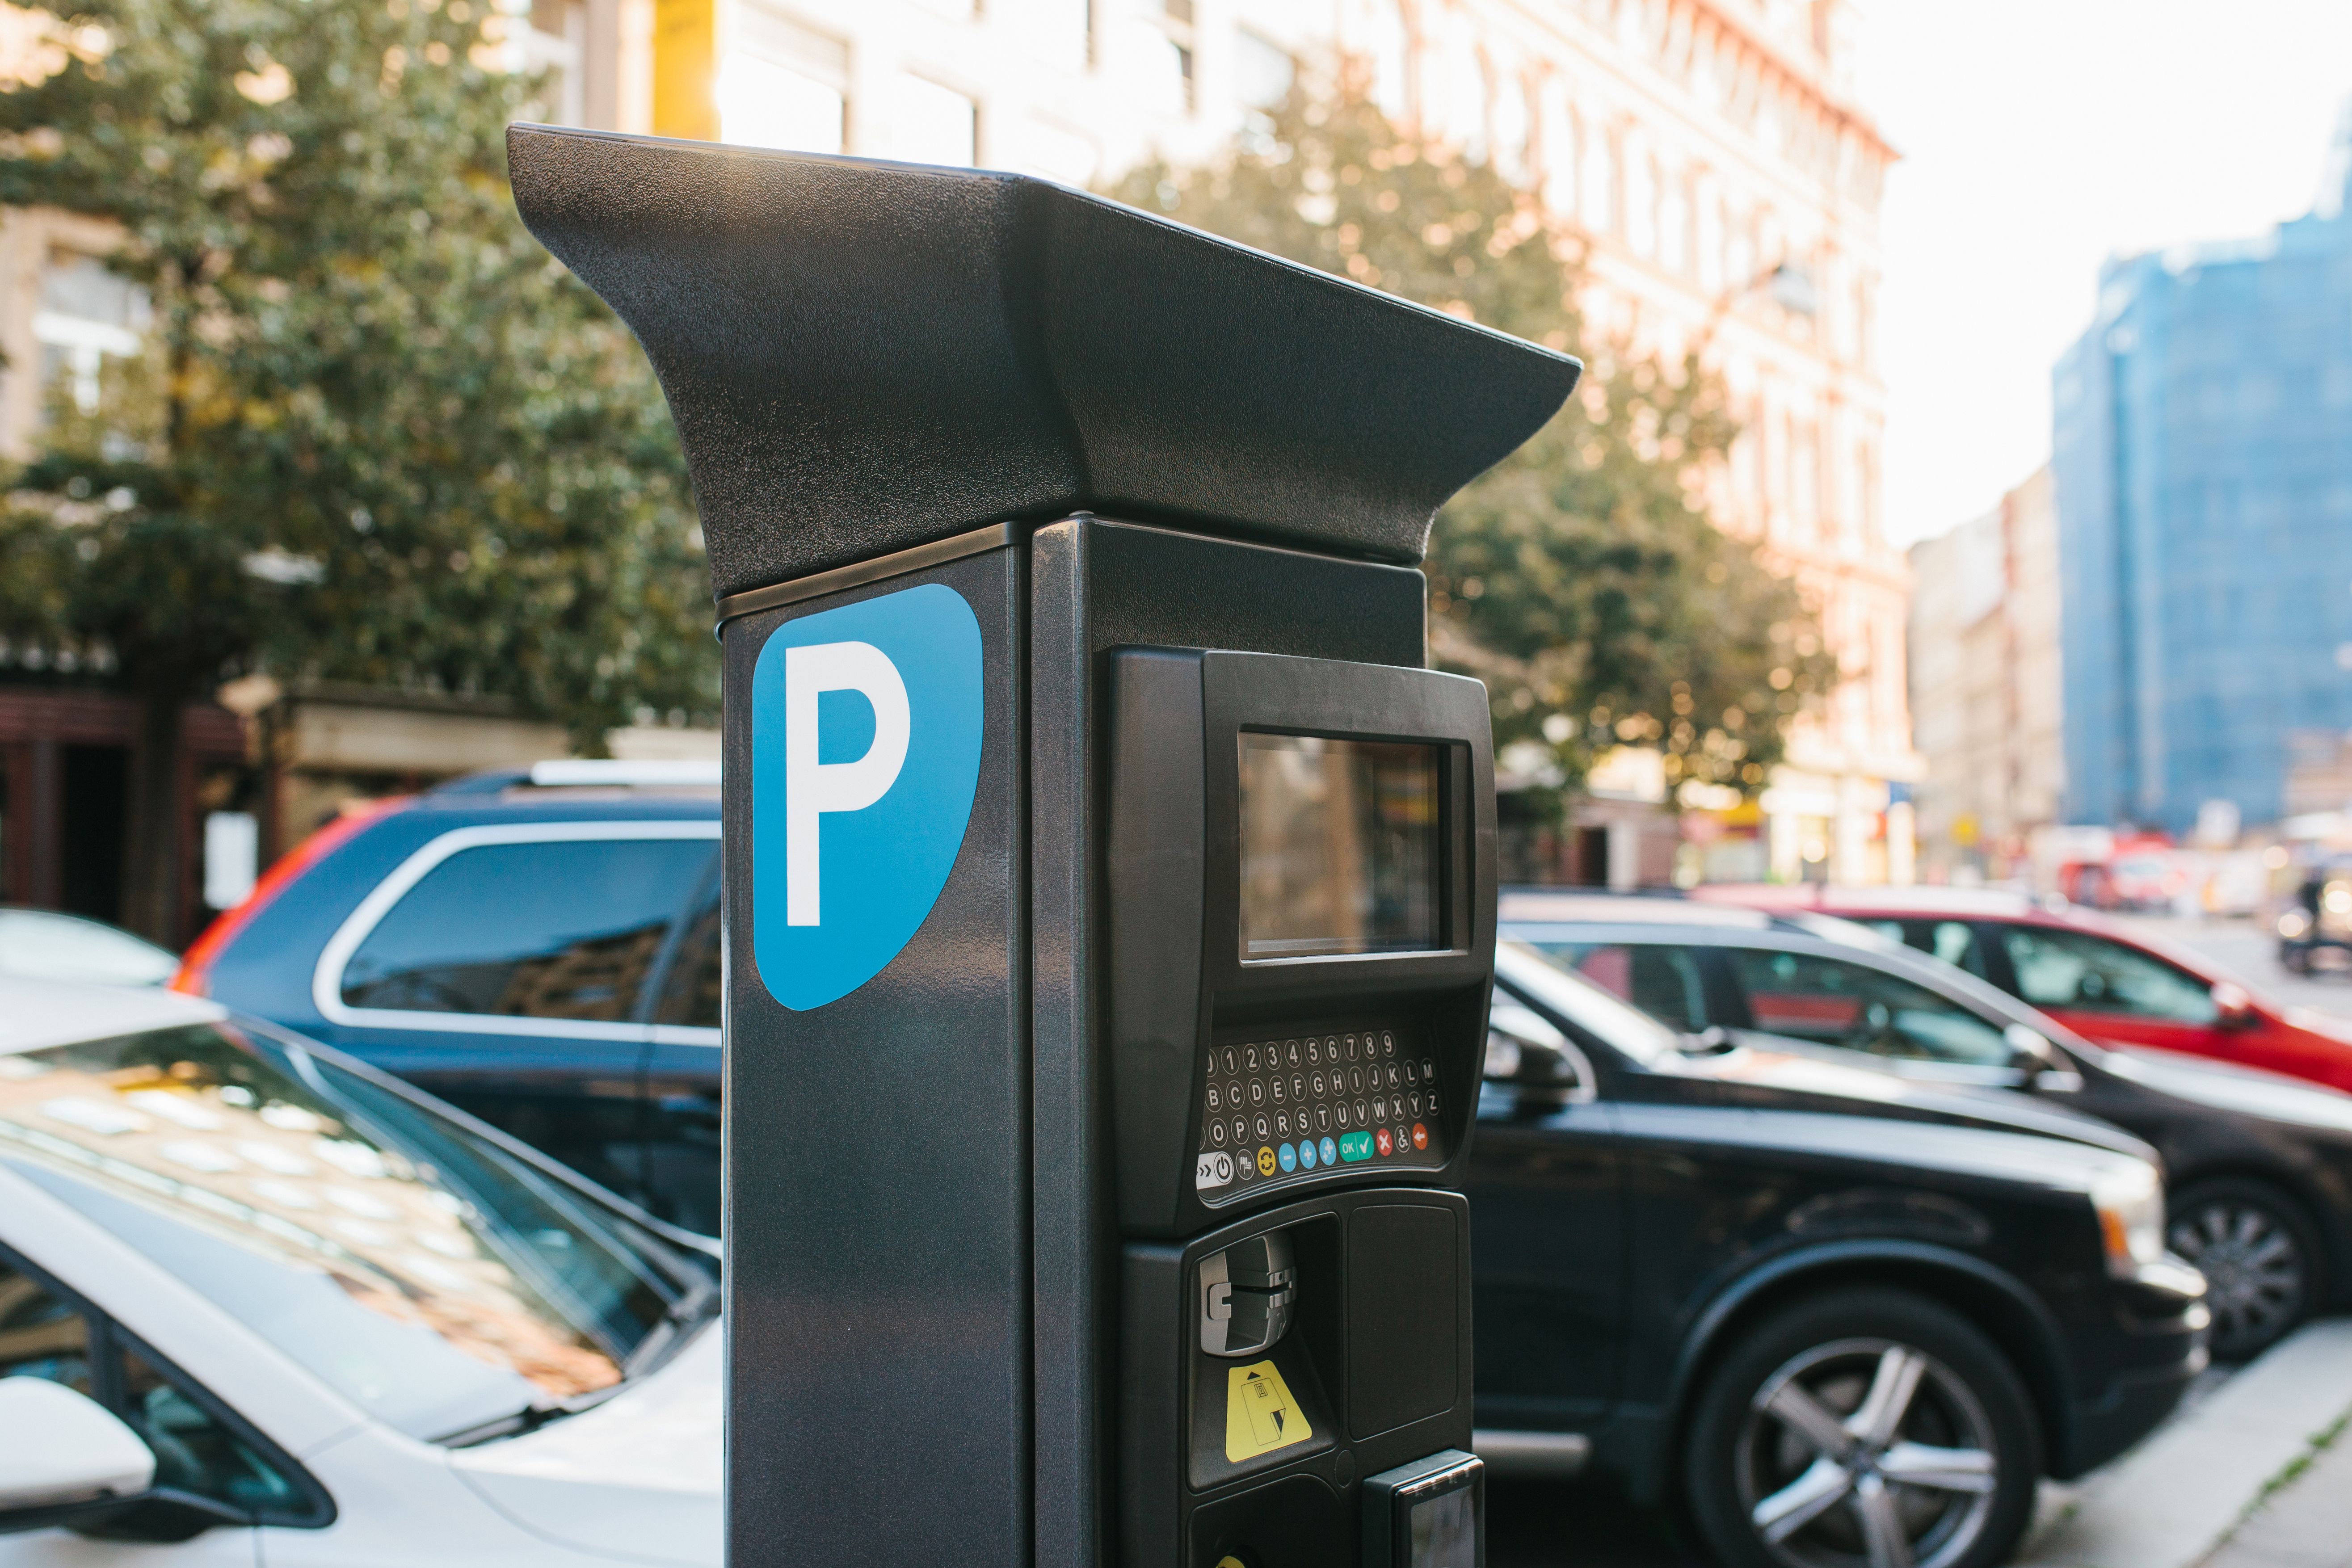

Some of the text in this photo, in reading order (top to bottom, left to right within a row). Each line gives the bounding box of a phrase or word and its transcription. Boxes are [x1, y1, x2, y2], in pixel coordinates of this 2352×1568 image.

[786, 641, 911, 926] P
[1226, 1051, 1234, 1070] 1
[1247, 1049, 1257, 1068] 2
[1268, 1047, 1277, 1065] 3
[1289, 1044, 1298, 1063] 4
[1309, 1043, 1317, 1061] 5
[1329, 1041, 1337, 1059] 6
[1347, 1038, 1354, 1056] 7
[1366, 1037, 1374, 1055] 8
[1384, 1035, 1392, 1053] 9
[1208, 1064, 1433, 1106] B C D E F G H I J K L M
[1213, 1095, 1437, 1141] O P Q R S T U V W X Y Z
[1342, 1142, 1355, 1154] OK
